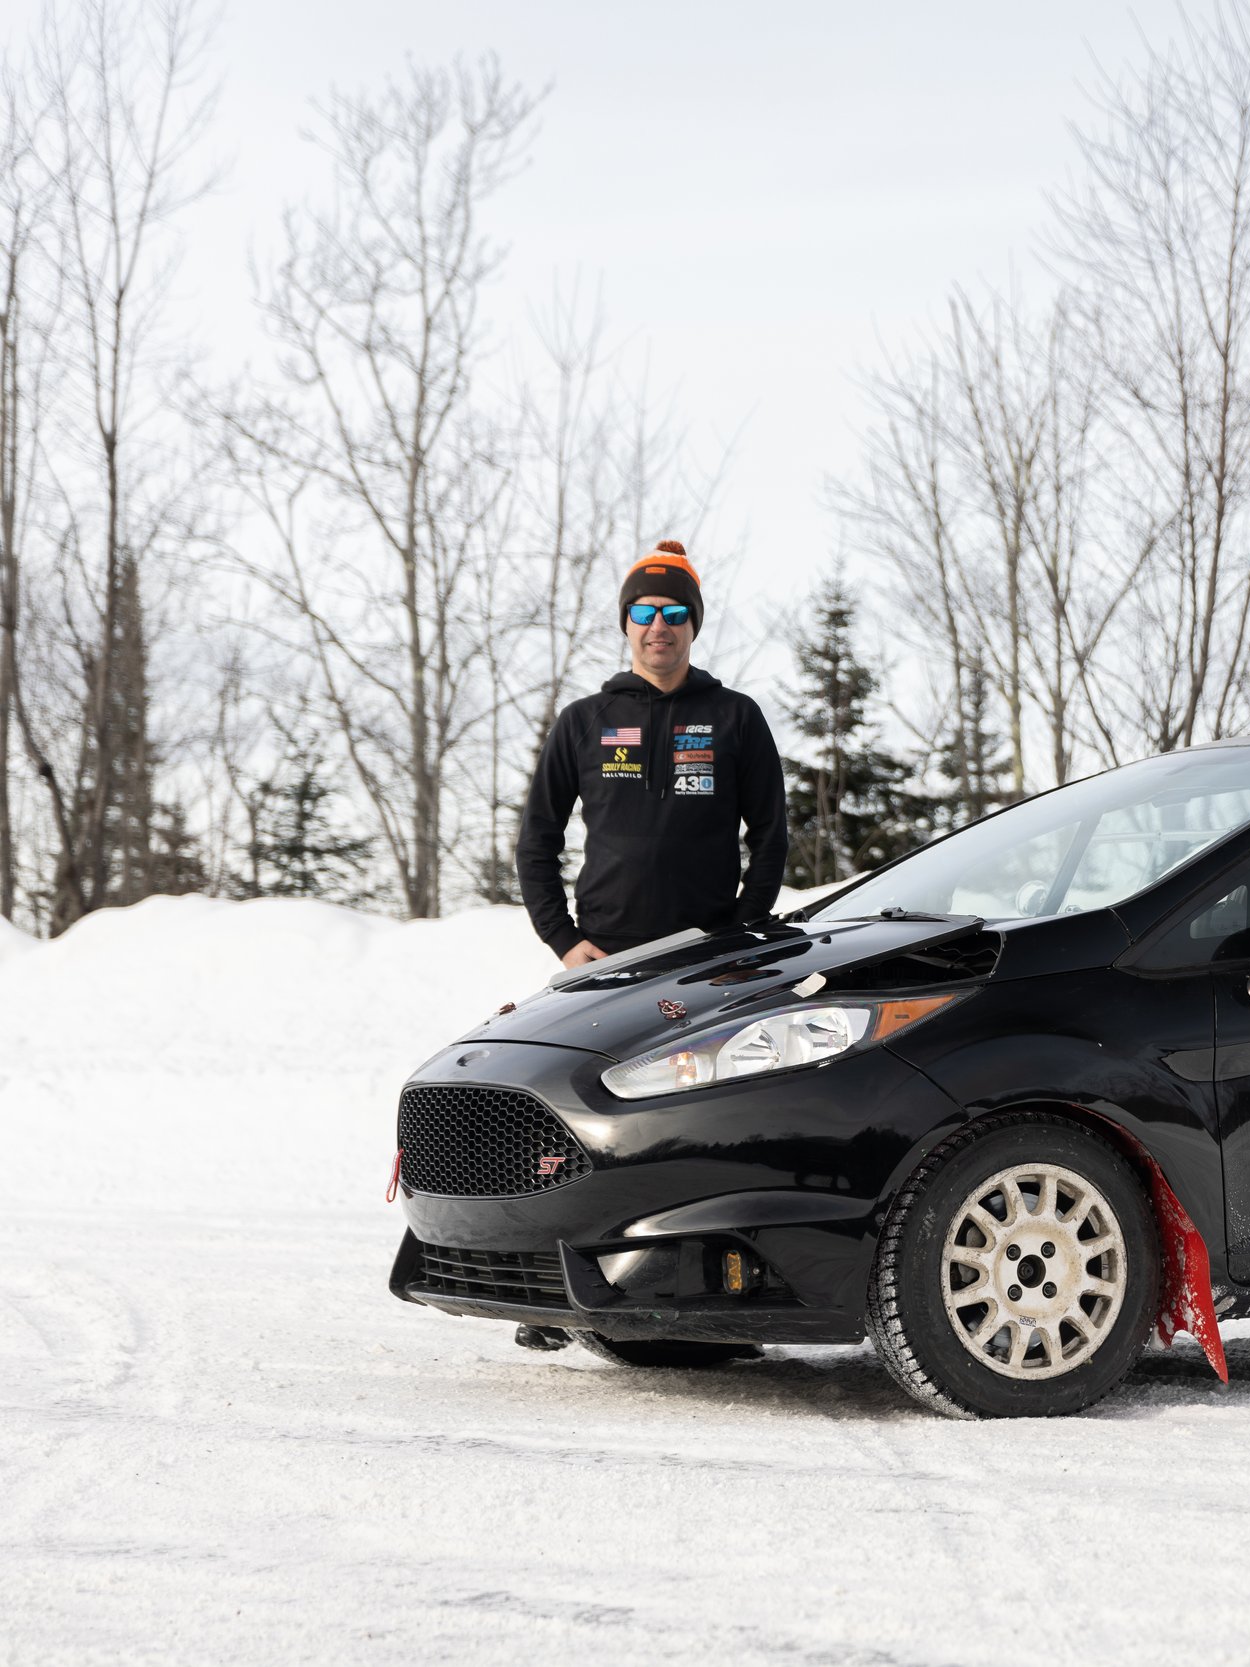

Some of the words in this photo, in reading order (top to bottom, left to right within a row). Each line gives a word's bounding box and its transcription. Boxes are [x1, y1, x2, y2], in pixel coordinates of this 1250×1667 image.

[686, 725, 712, 733] RRS
[674, 735, 712, 750] TRF
[620, 763, 641, 772] RACING
[537, 1156, 566, 1174] ST
